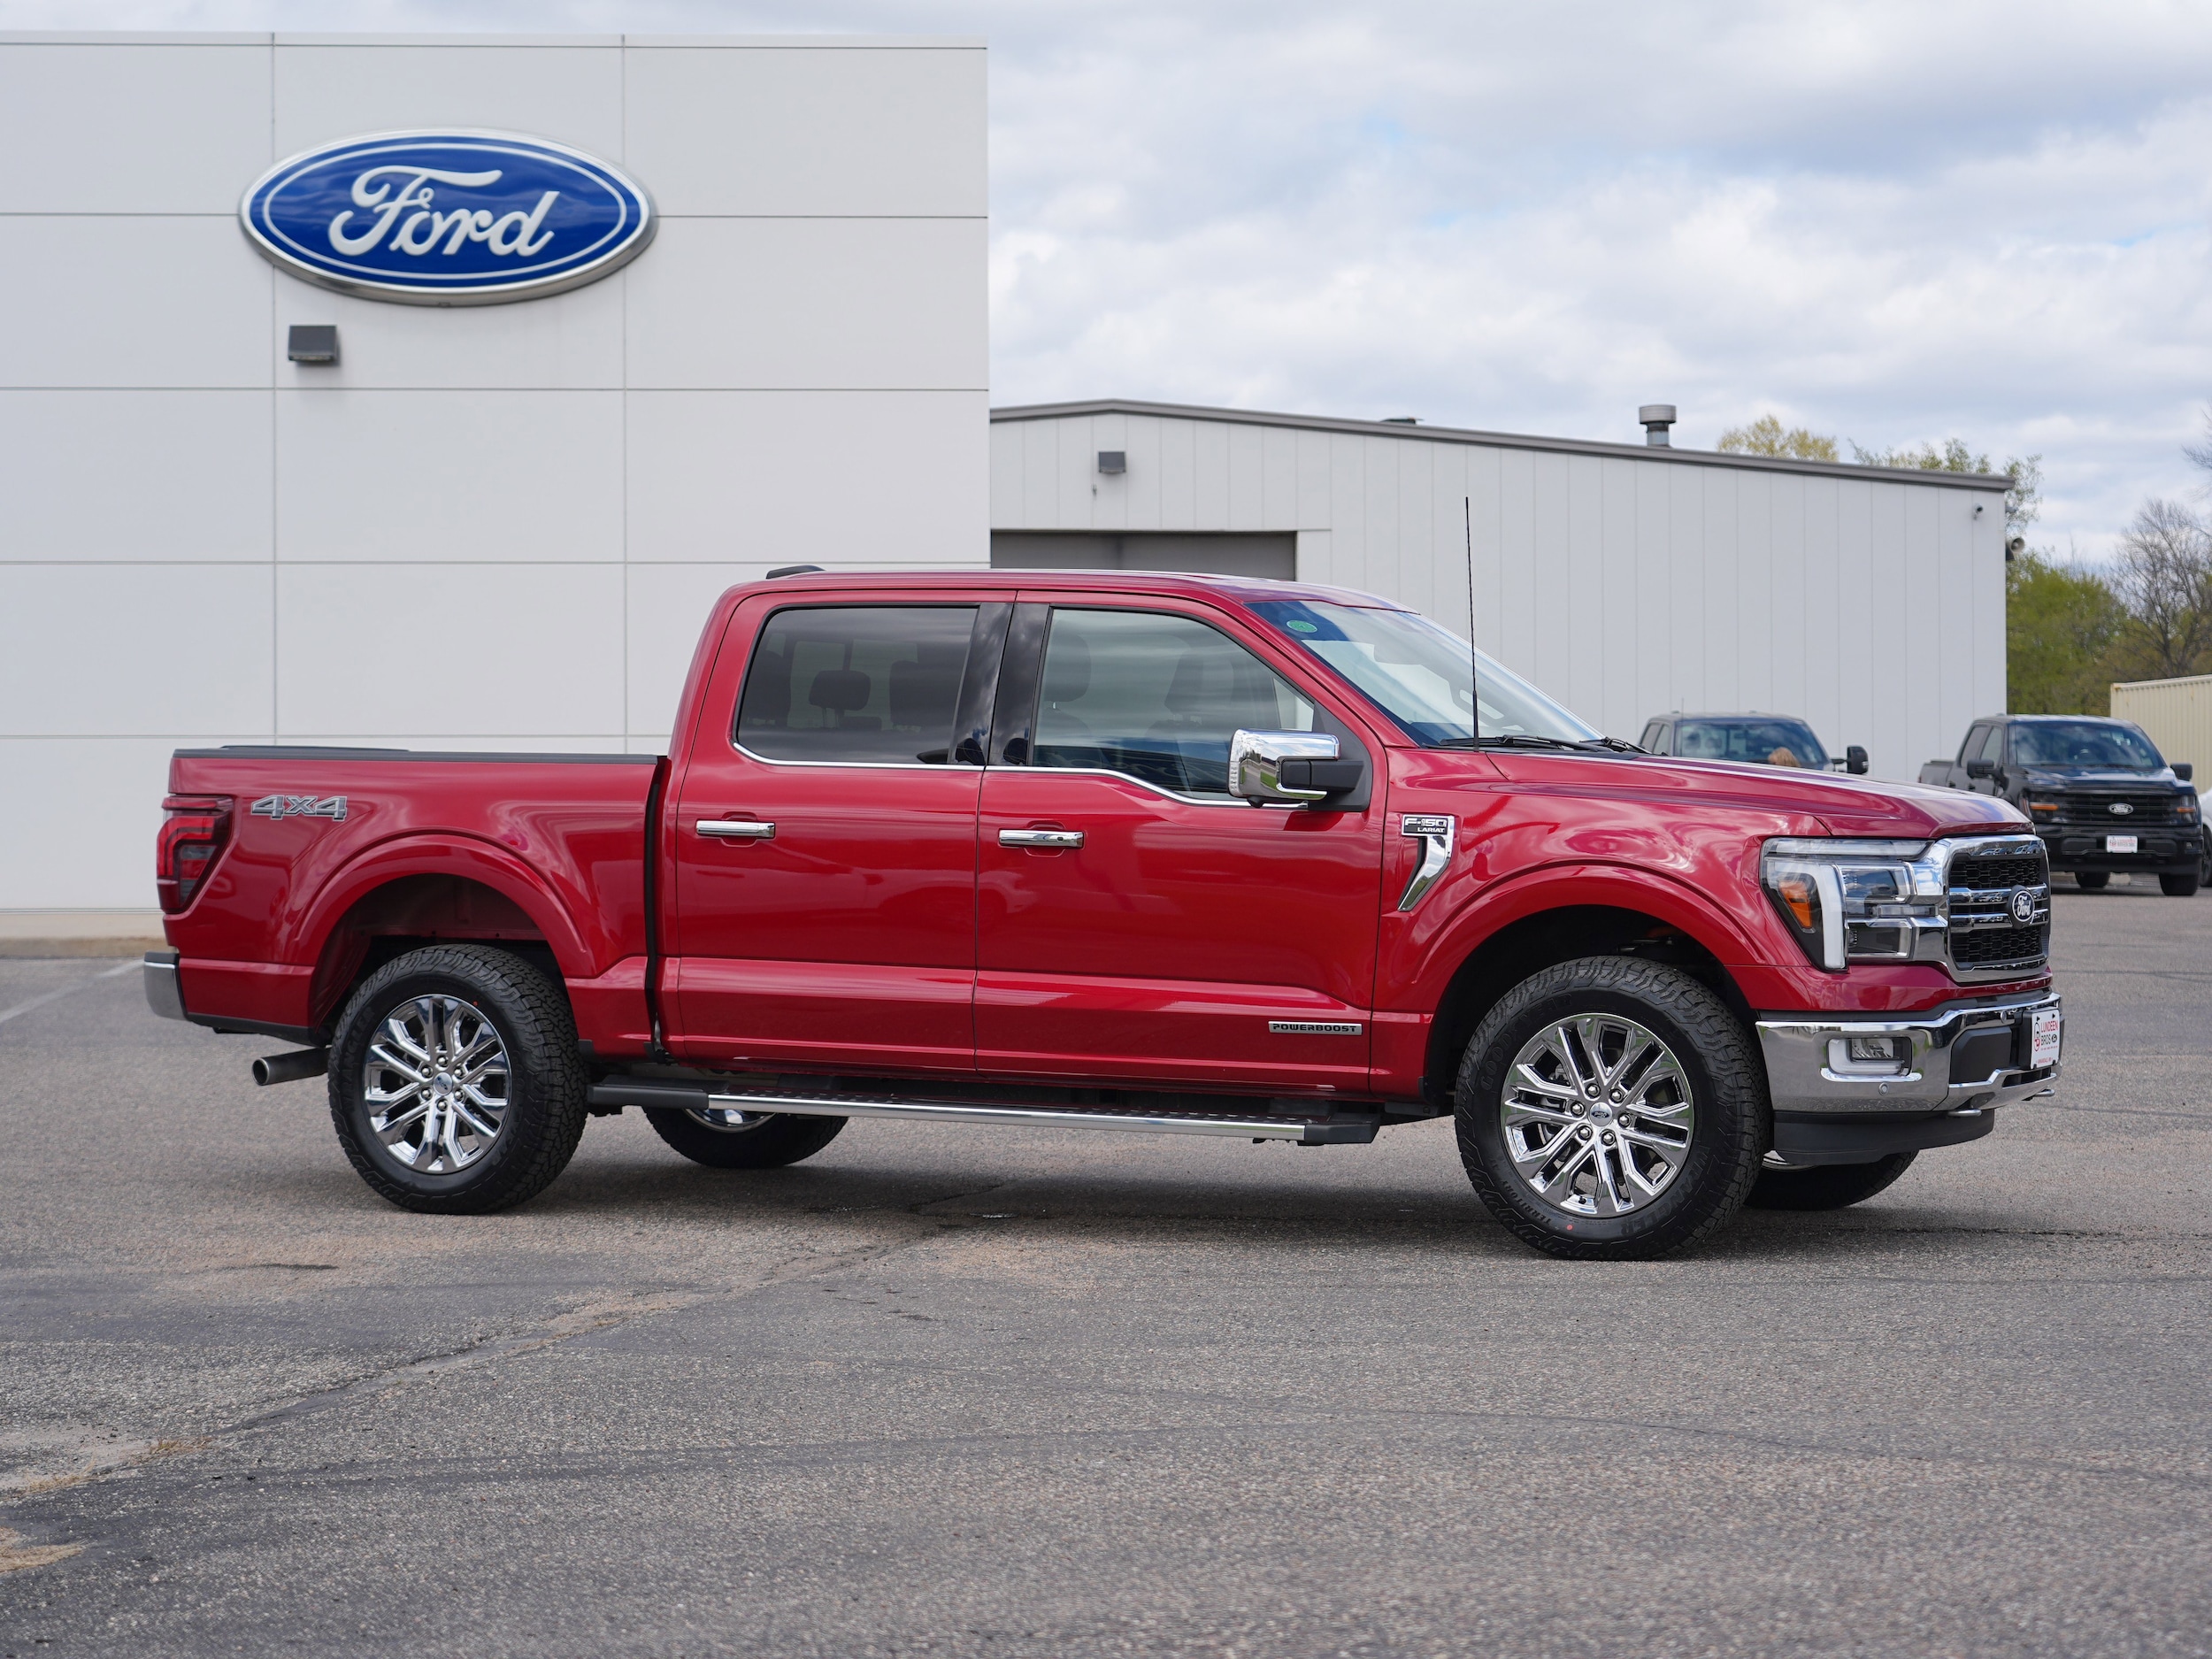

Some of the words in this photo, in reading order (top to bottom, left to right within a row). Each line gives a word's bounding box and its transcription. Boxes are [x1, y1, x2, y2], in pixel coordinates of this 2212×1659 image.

[328, 165, 561, 257] Ford
[1404, 818, 1448, 826] F-150
[2017, 895, 2032, 917] Ford
[1272, 1023, 1357, 1033] POWERBOOST
[2040, 1020, 2059, 1033] LUNDEEN
[2040, 1033, 2051, 1046] BROS
[1500, 1179, 1553, 1226] TERRITORY
